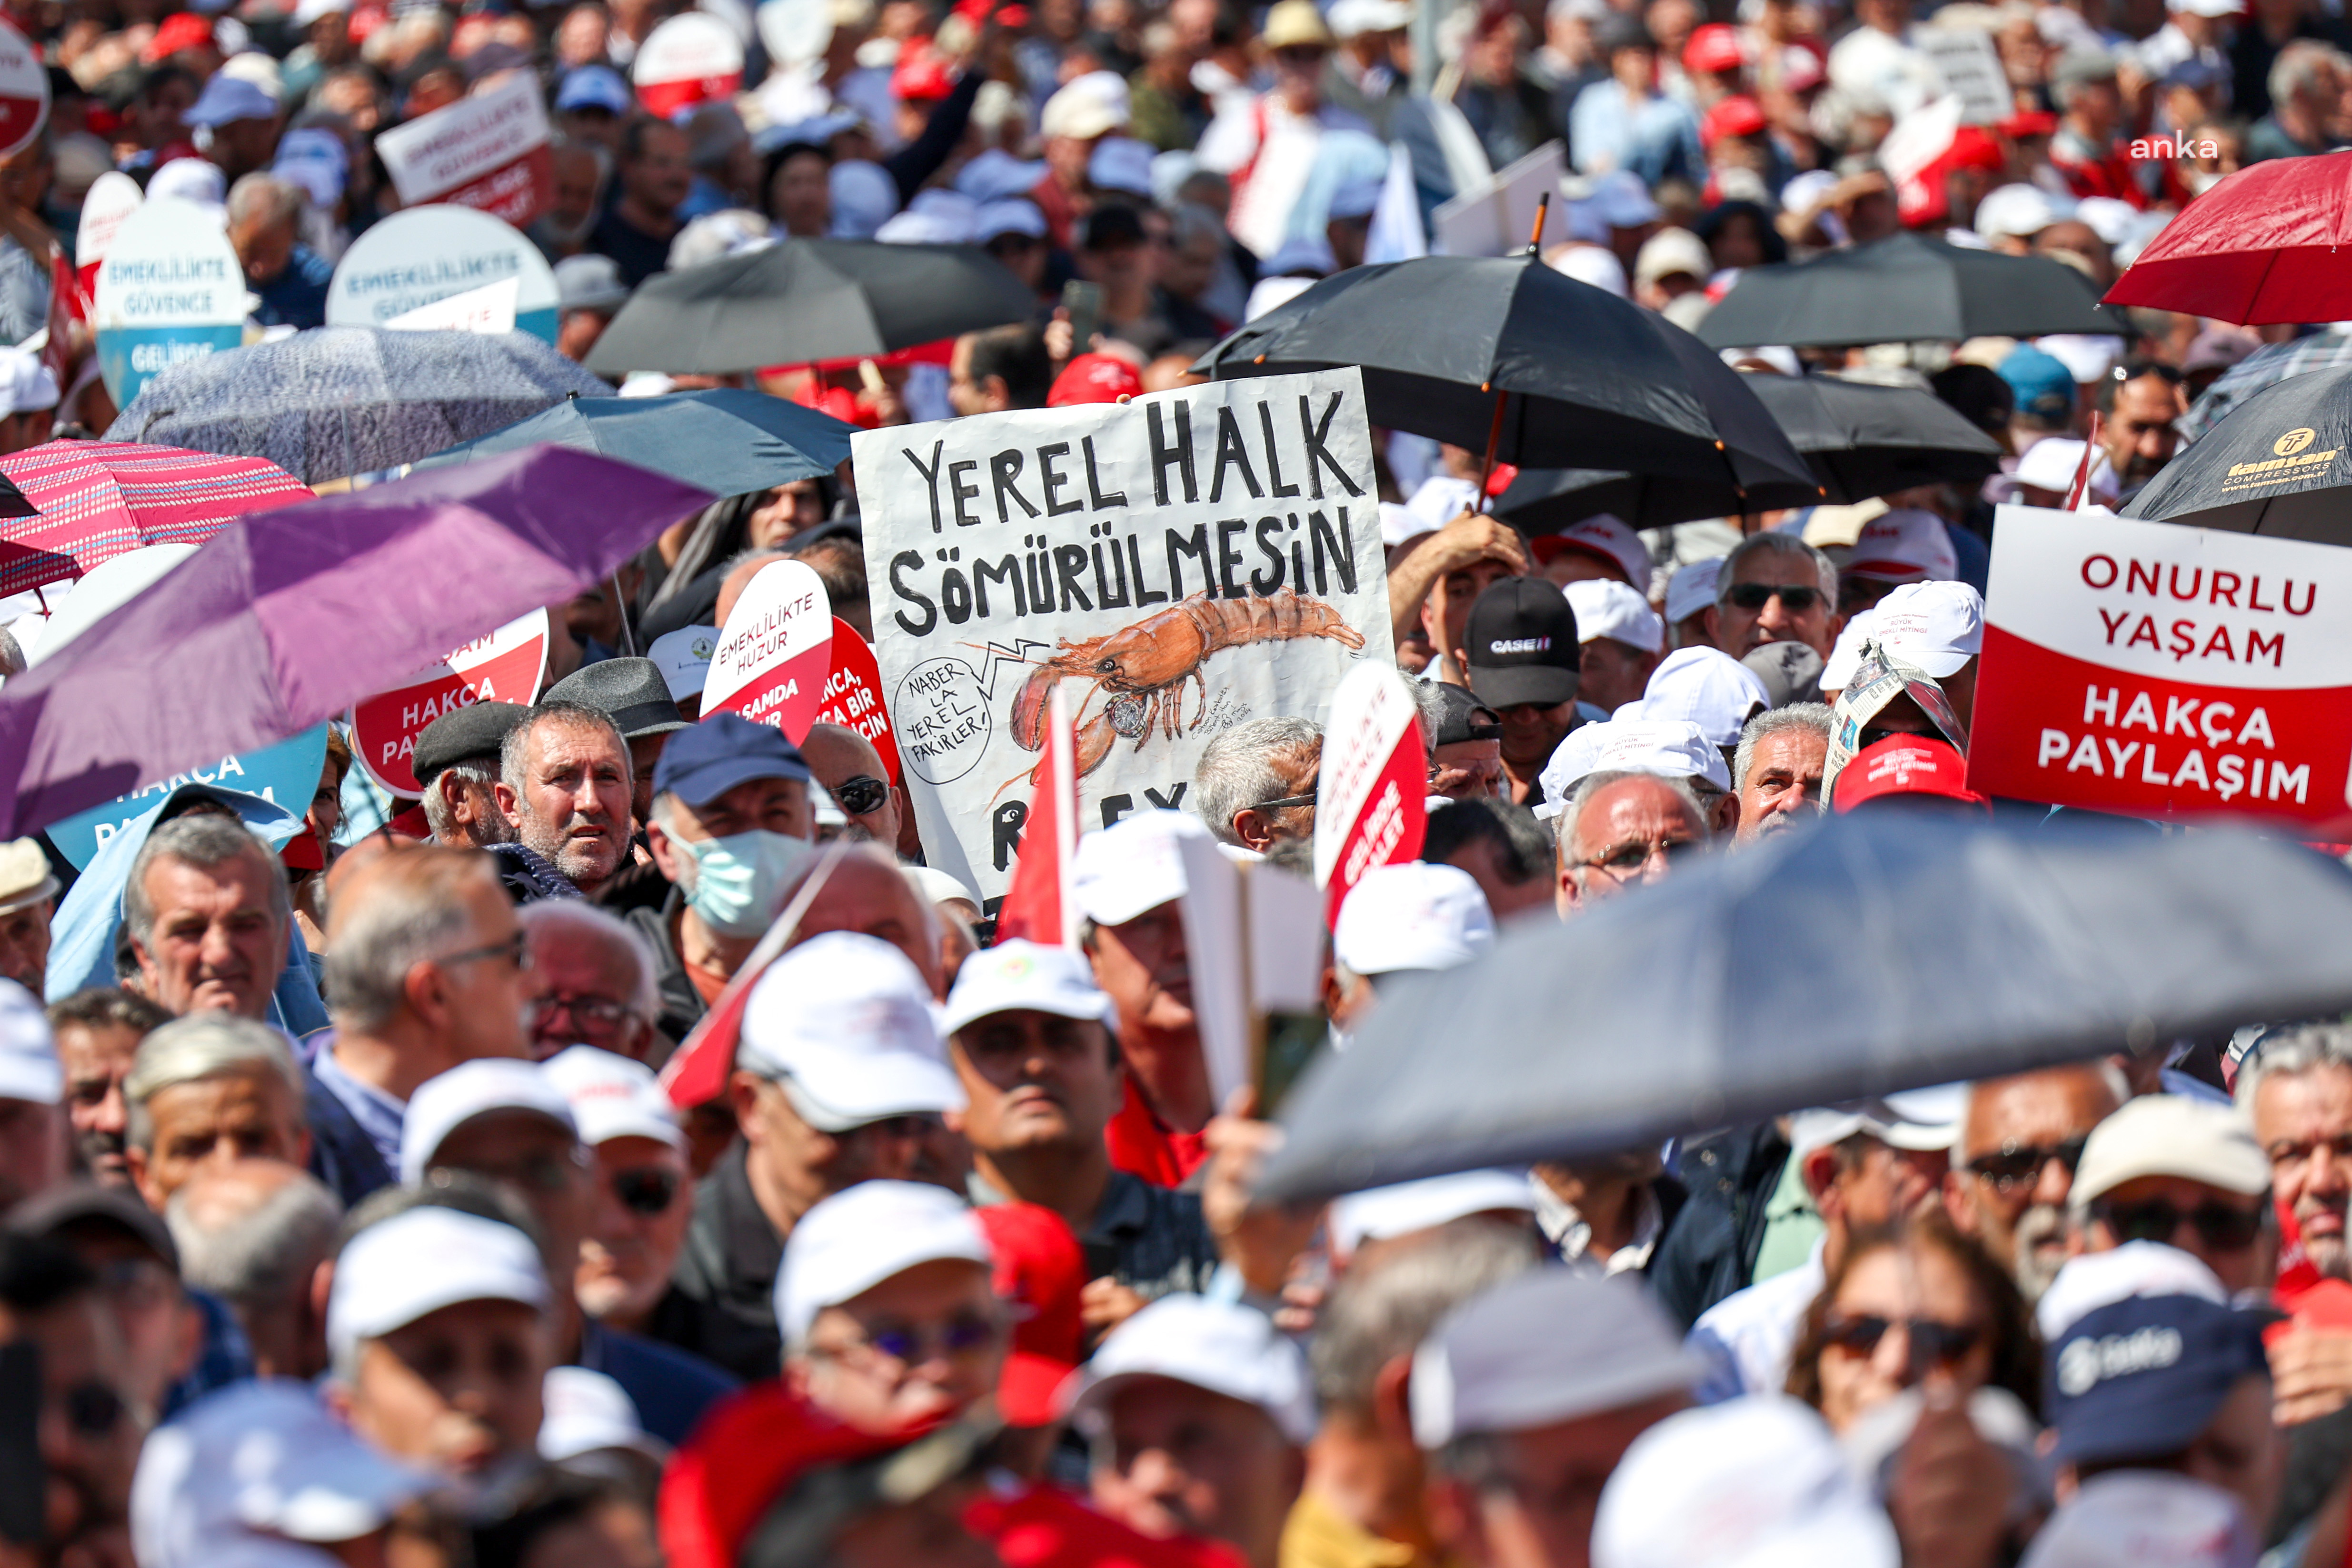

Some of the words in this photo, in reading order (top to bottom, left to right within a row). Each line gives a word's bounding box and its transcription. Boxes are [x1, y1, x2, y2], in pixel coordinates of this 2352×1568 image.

[902, 435, 1128, 533] YEREL
[1146, 390, 1366, 507] HALK
[2224, 462, 2331, 485] COMPRESSORS
[2222, 471, 2327, 492] www.tamsan.com.tr
[889, 506, 1358, 637] SÖMÜRÜLMESİN
[2082, 555, 2316, 616] ONURLU
[720, 592, 813, 666] EMEKLİLİKTE
[1879, 626, 1898, 636] EMEKLİ
[1900, 626, 1928, 634] MİTİNGİ
[1890, 618, 1913, 626] BÜYÜK
[2099, 607, 2285, 668] YAŞAM
[737, 631, 788, 676] HUZUR
[1490, 639, 1537, 654] CASE
[909, 663, 965, 698] NABER
[930, 689, 958, 707] LA
[846, 687, 876, 719] BİR
[907, 702, 977, 740] YEREL
[1237, 708, 1252, 721] 2024
[2083, 684, 2275, 750] HAKÇA
[911, 712, 988, 762] FAKİRLER!
[2038, 727, 2310, 805] PAYLAŞIM
